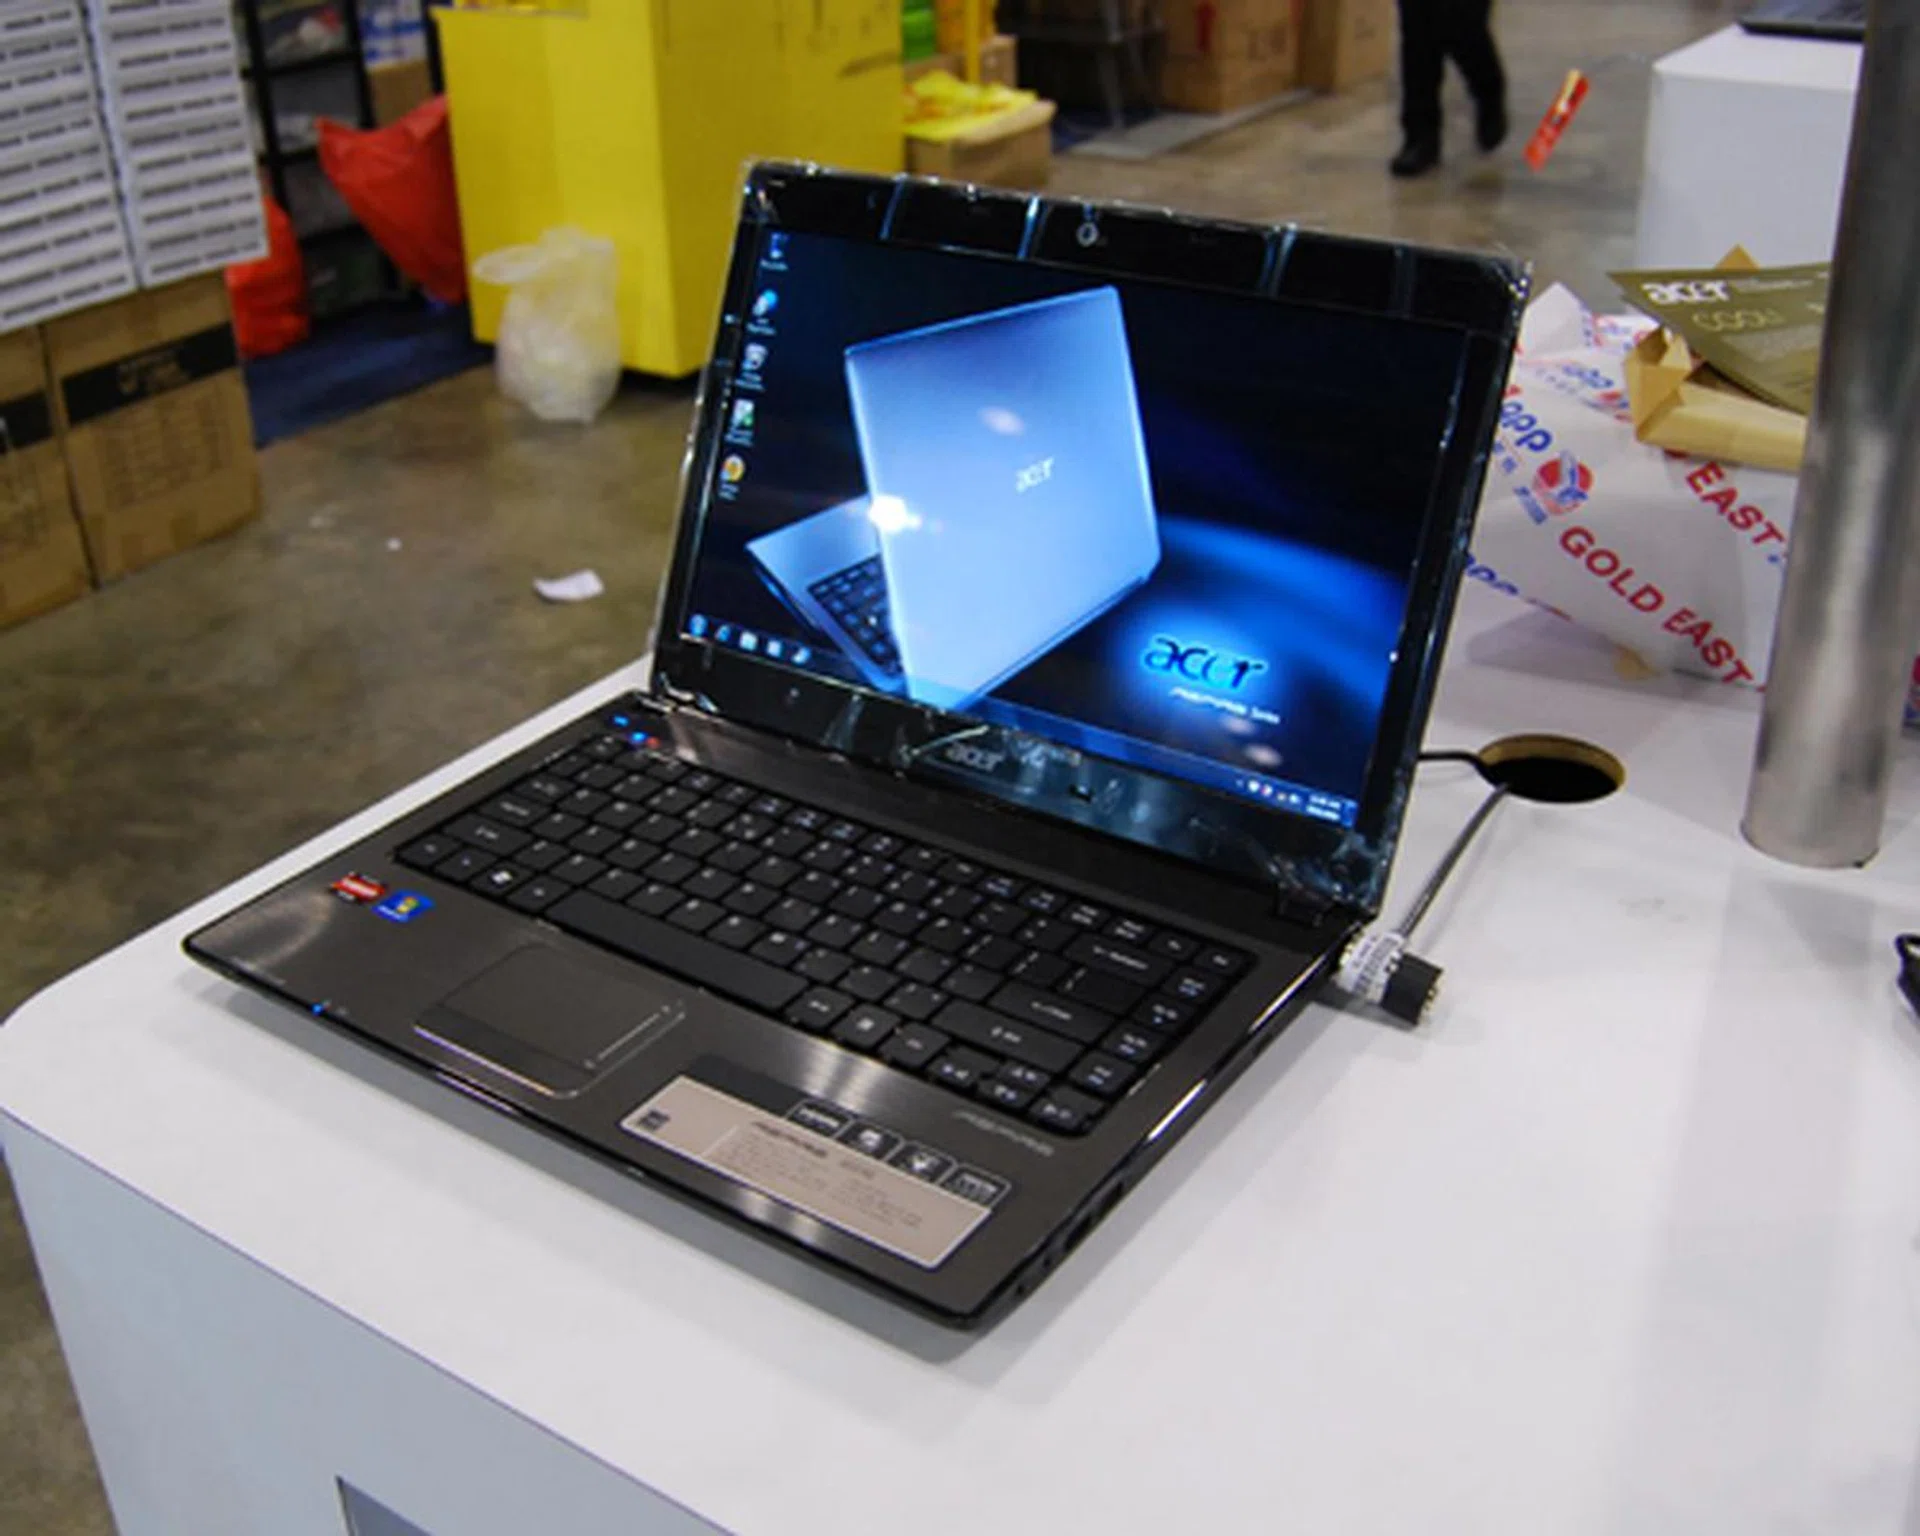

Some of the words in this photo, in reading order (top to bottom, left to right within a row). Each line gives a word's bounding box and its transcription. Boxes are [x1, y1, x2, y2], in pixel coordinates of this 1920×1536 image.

[1641, 279, 1730, 305] acer
[1685, 460, 1785, 545] EAST
[1559, 526, 1665, 614] GOLD
[1662, 607, 1754, 684] EAST
